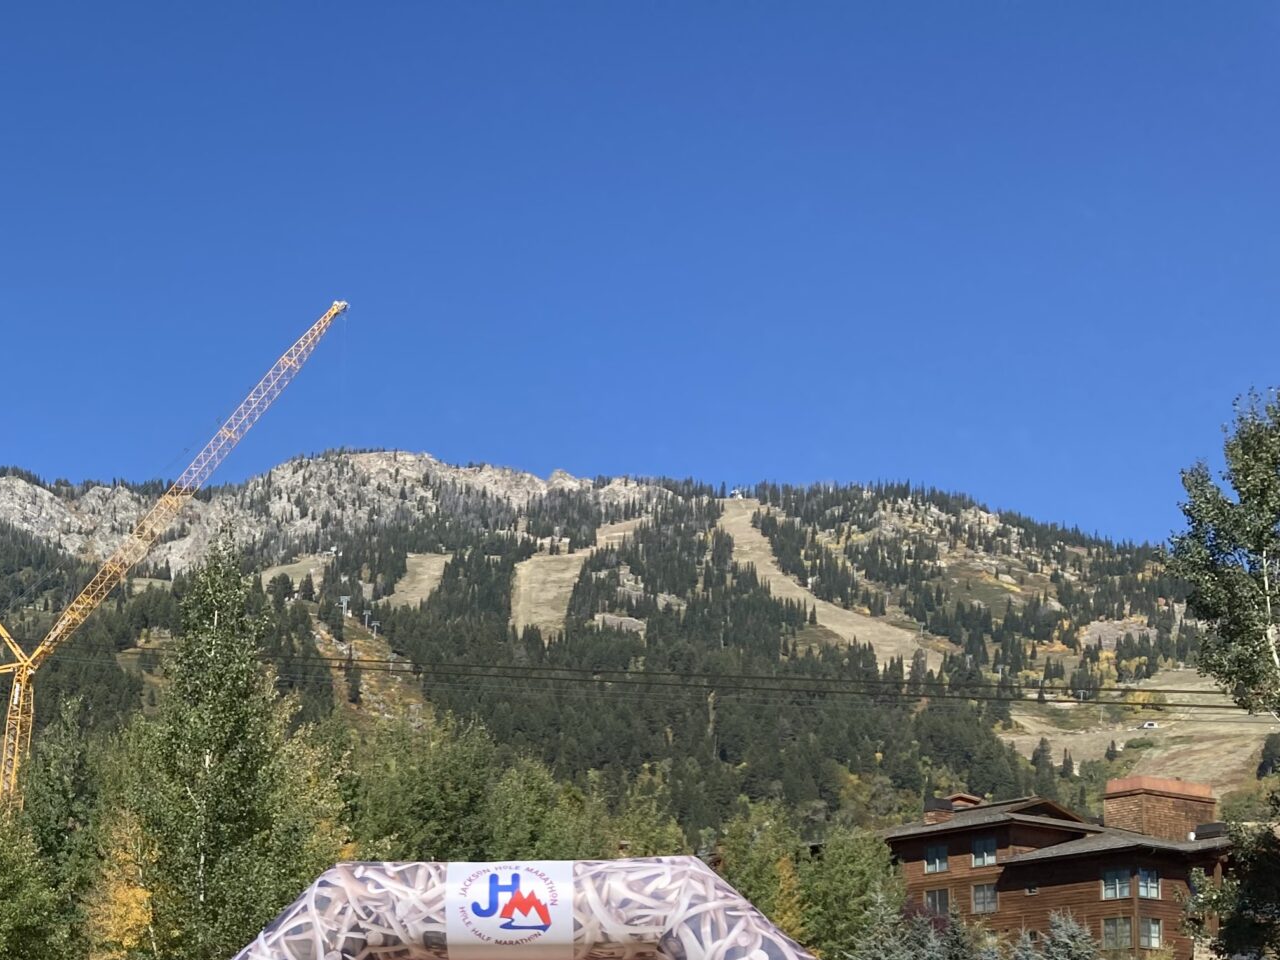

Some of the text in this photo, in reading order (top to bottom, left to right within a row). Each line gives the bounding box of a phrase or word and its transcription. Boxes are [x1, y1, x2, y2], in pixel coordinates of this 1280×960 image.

[459, 868, 491, 897] JACKSON
[524, 866, 559, 907] MARATHON
[459, 905, 542, 946] HOLE HALF MARATHON
